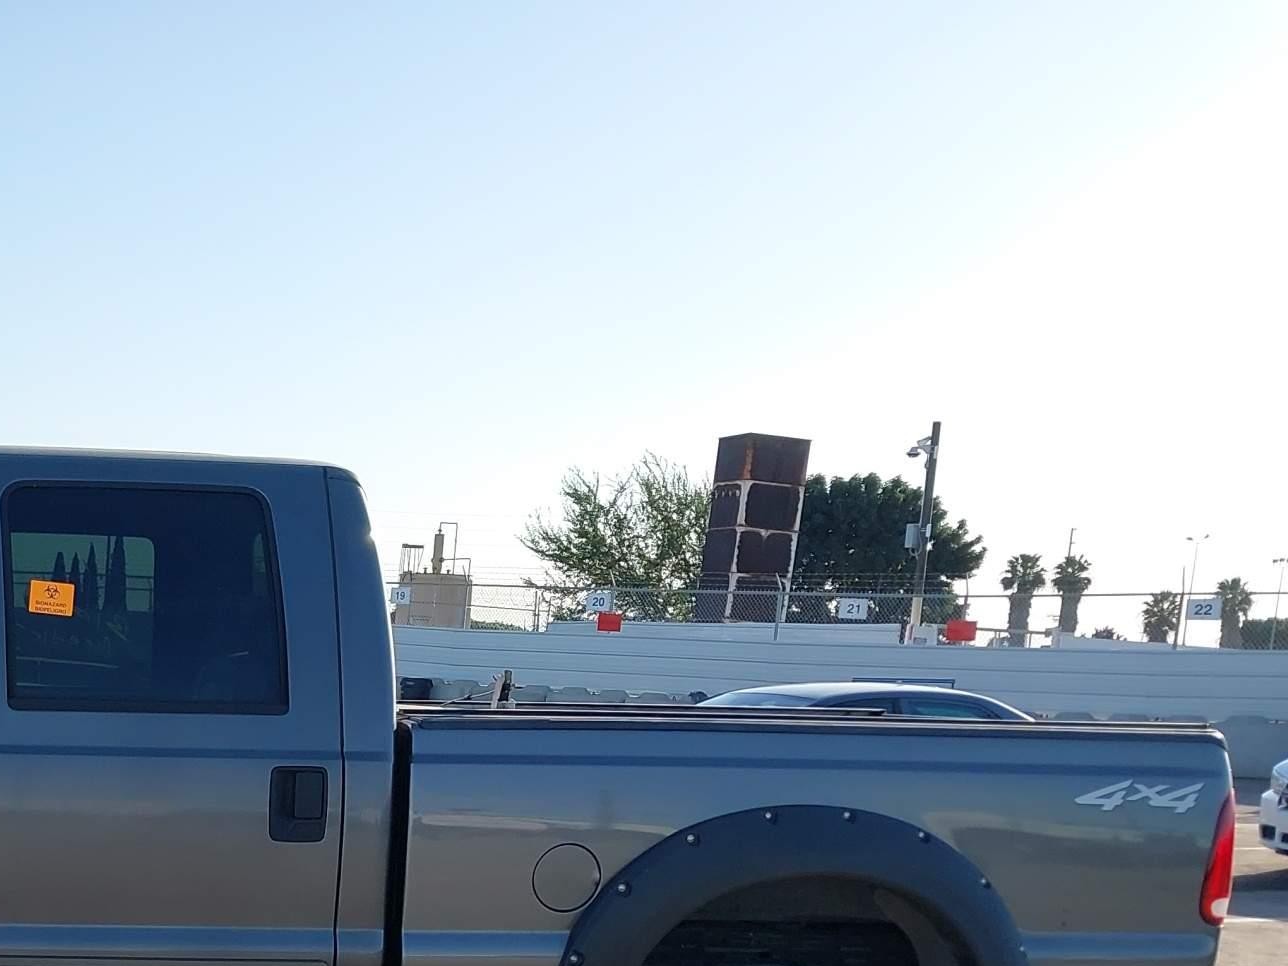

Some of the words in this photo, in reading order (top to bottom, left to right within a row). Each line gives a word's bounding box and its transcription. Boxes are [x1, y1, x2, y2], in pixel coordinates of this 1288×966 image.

[395, 591, 406, 601] 19
[592, 597, 605, 607] 20
[847, 603, 861, 614] 21
[1194, 603, 1213, 616] 22
